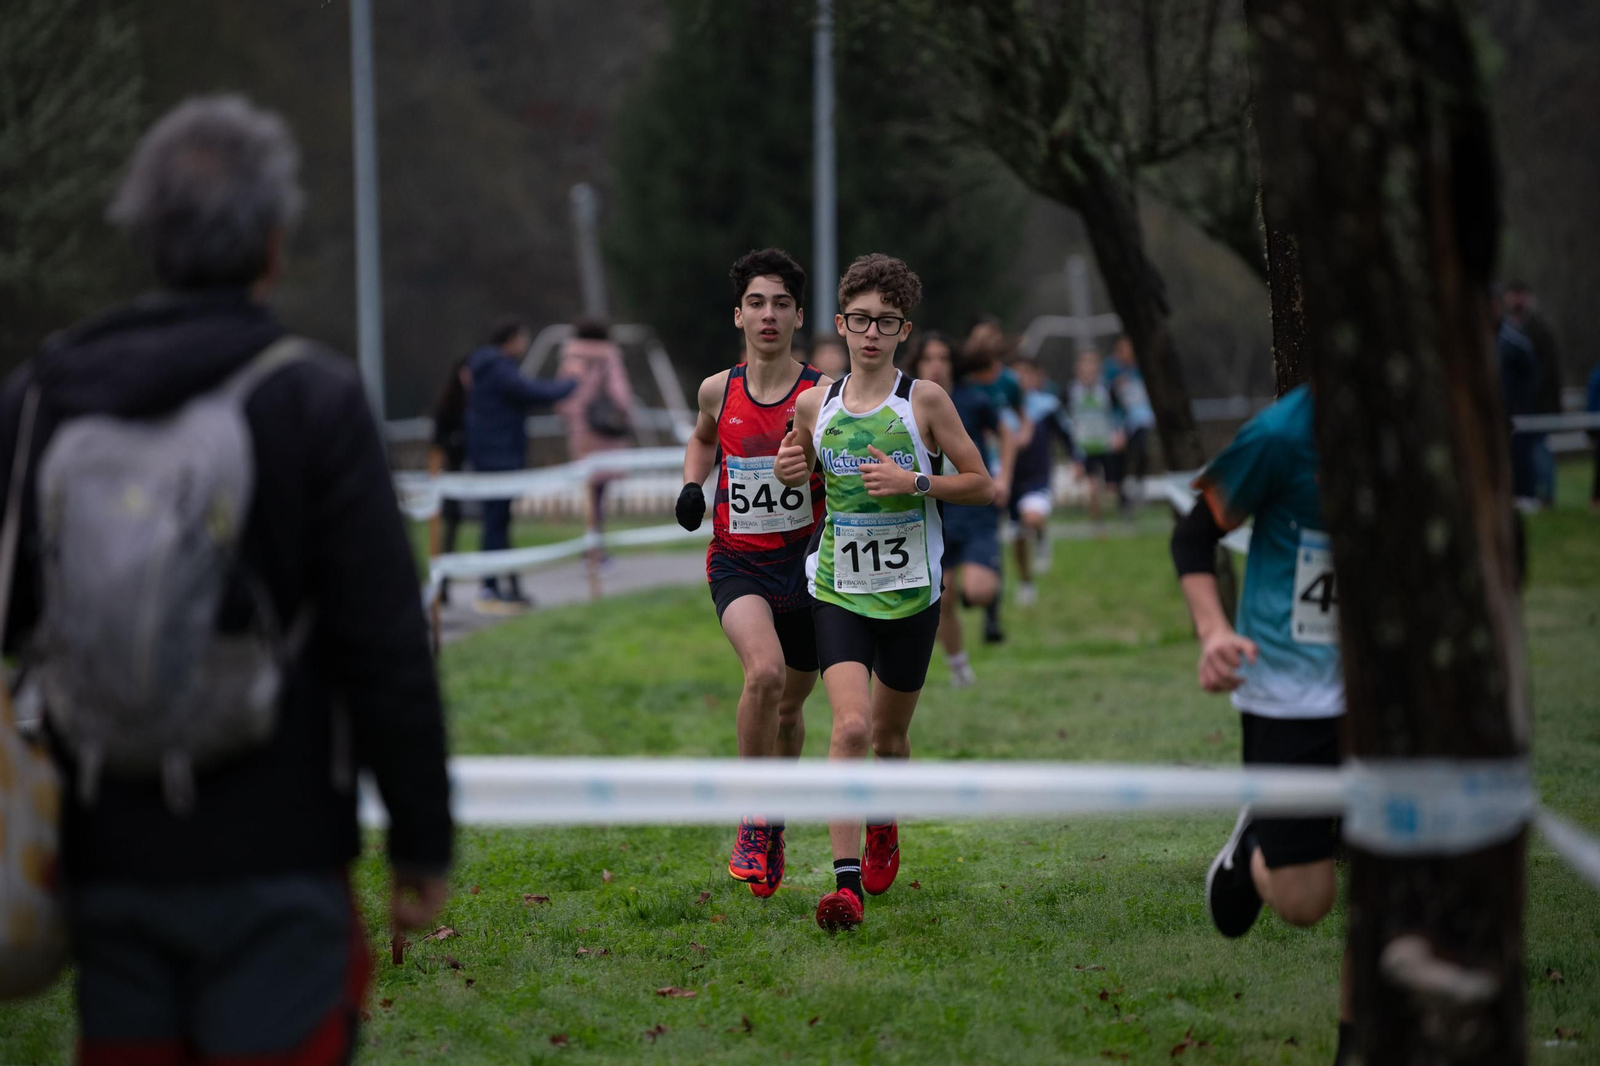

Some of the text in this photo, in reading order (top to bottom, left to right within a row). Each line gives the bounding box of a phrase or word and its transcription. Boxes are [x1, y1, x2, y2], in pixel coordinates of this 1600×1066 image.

[731, 483, 804, 514] 546
[878, 517, 906, 525] ESCOLAR
[841, 537, 909, 573] 113
[1300, 571, 1339, 613] 4
